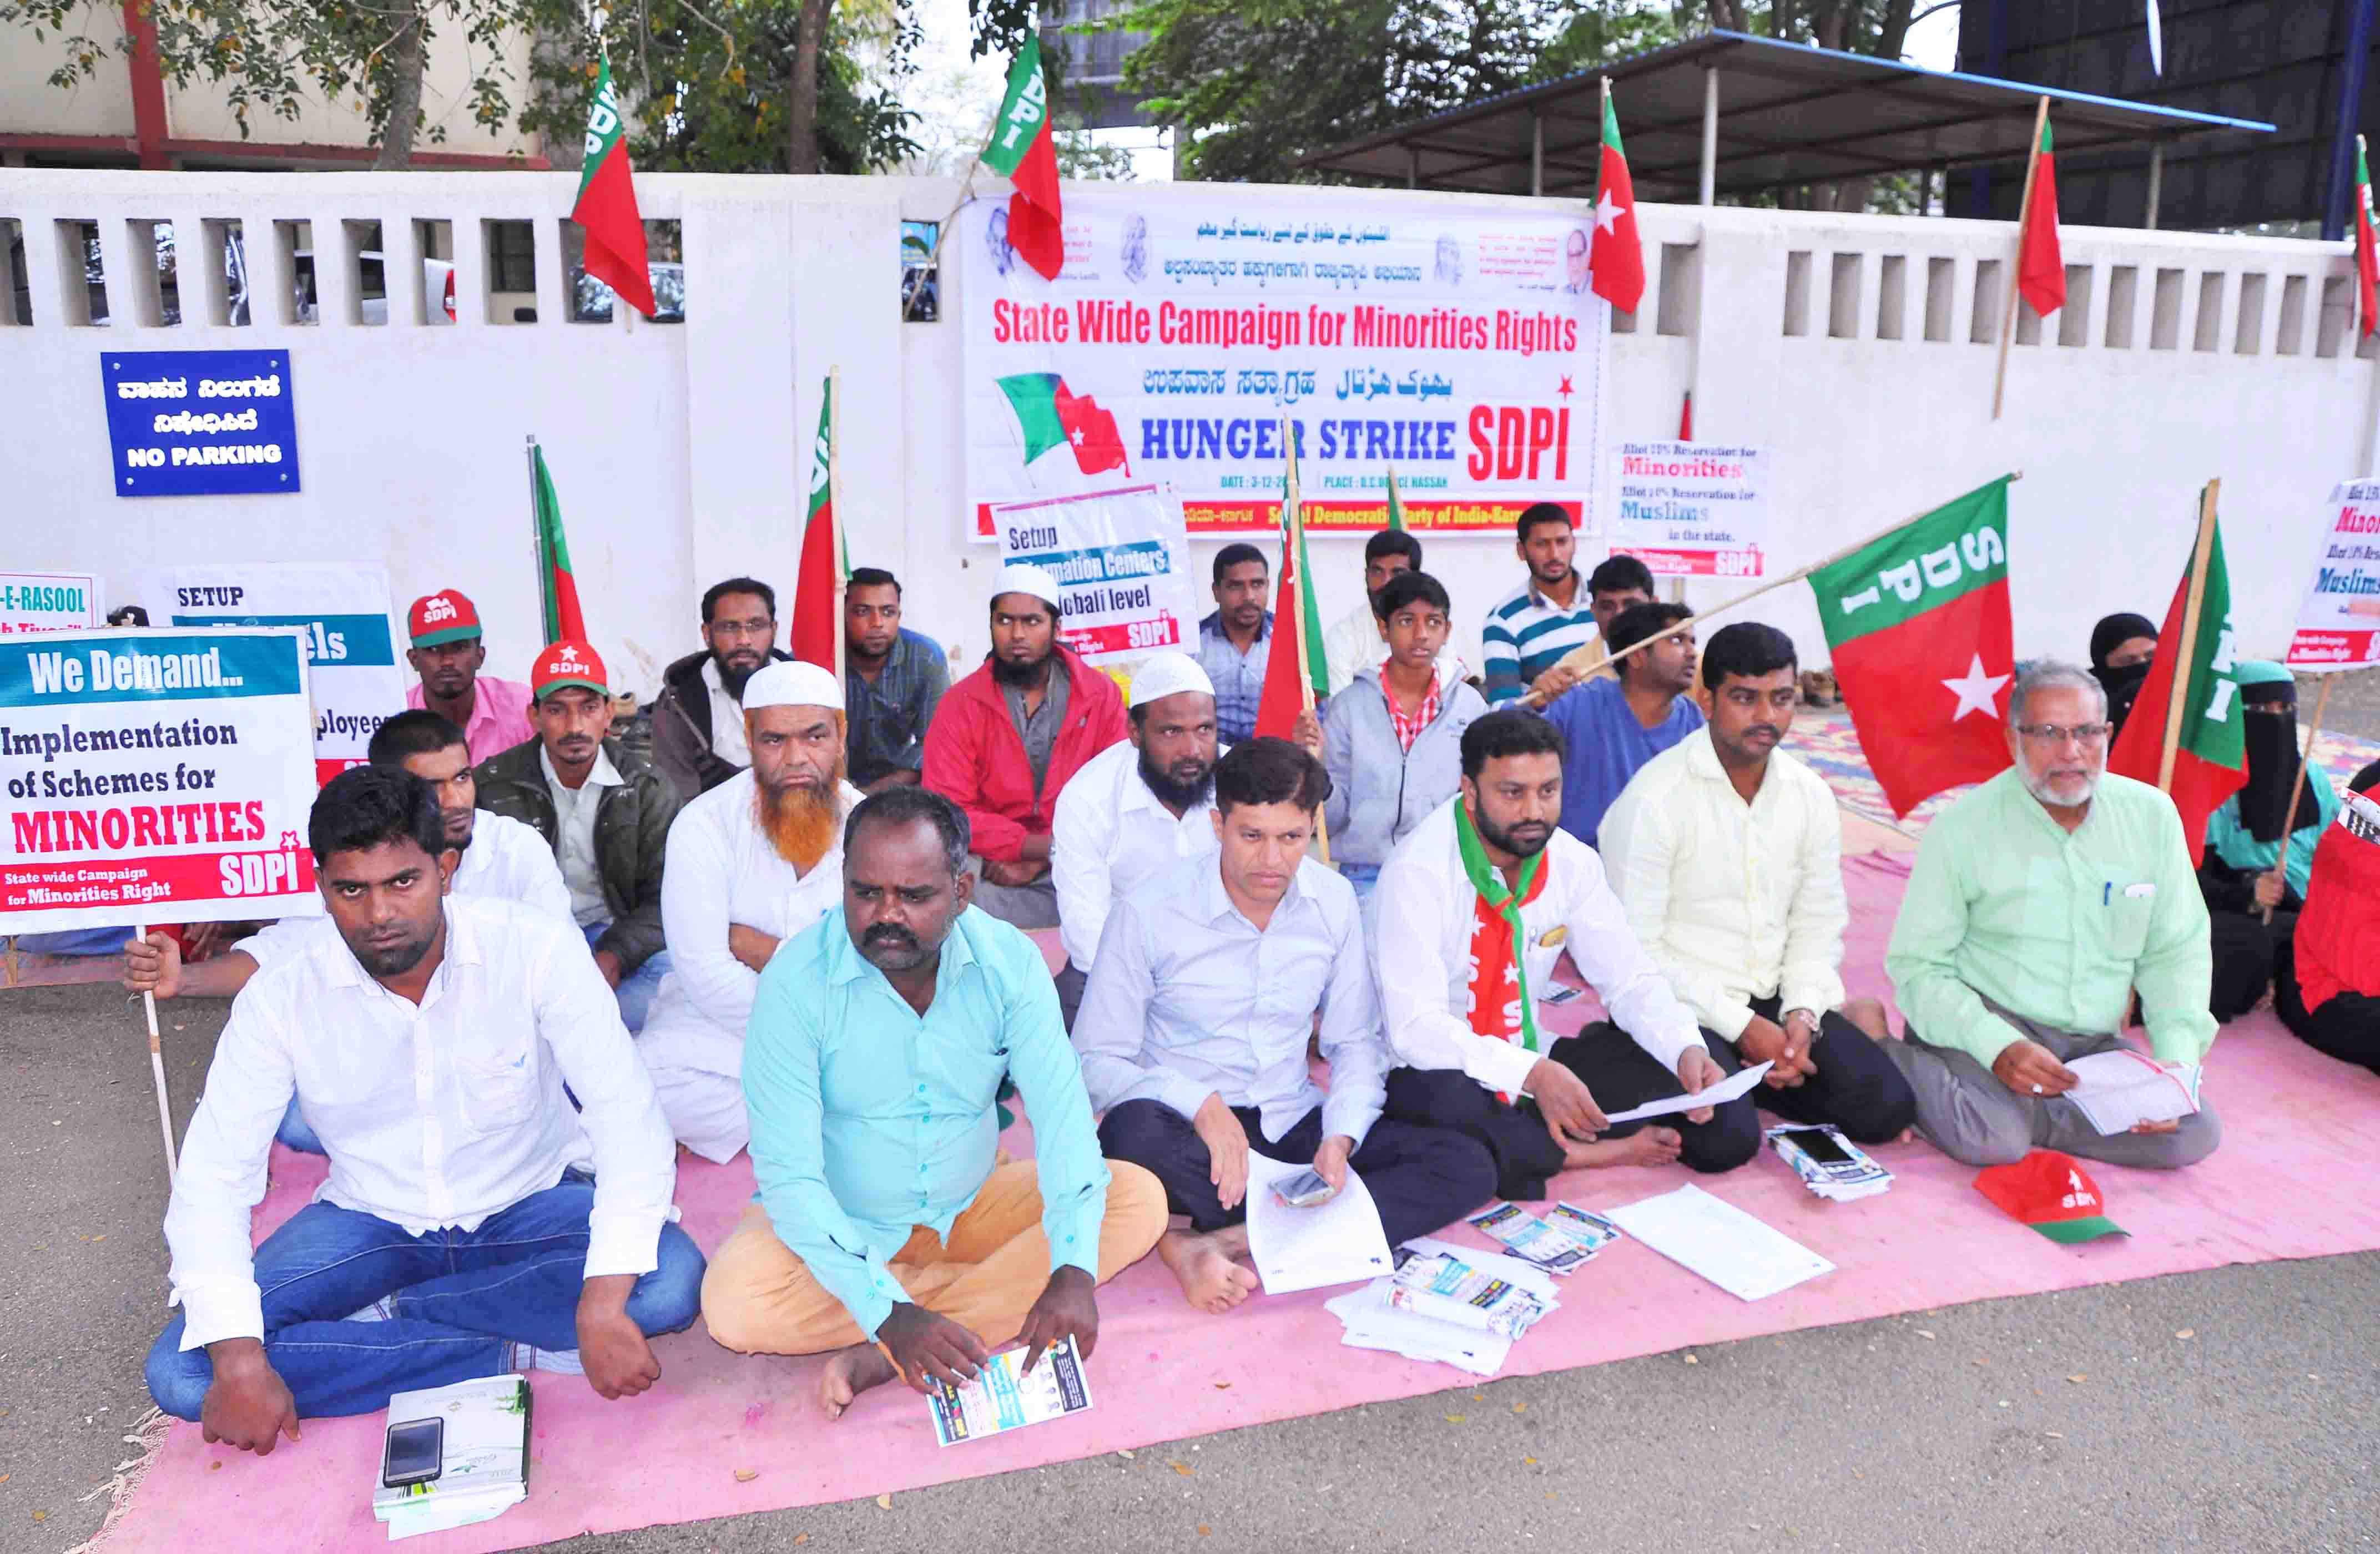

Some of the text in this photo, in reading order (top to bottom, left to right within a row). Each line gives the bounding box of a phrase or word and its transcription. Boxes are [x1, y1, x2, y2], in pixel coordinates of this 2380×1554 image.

[994, 298, 1578, 356] State Wide Campaign for Minorities Rights
[1141, 419, 1456, 460] HUNGER STRIKE
[1468, 405, 1570, 481] SDPI
[127, 444, 282, 467] NO PARKING
[1623, 456, 1743, 477] Minorities
[1221, 476, 1243, 488] DATE
[1324, 476, 1354, 488] PLACE
[1314, 506, 1389, 525] Democrati
[1437, 506, 1450, 524] of
[1621, 501, 1708, 521] Muslims
[1009, 526, 1058, 550] Setup
[1105, 549, 1165, 577] Centers
[1841, 526, 2005, 614] SDPI
[178, 587, 244, 607] SETUP
[1109, 584, 1151, 610] level
[1128, 619, 1172, 648] SDPI
[28, 647, 244, 694] We Demand...
[549, 663, 590, 675] SDPI
[316, 709, 390, 741] ployee
[1, 718, 238, 763] Implementation
[8, 763, 216, 799] of Schemes for
[11, 800, 266, 854] MINORITIES
[4, 867, 148, 886] State wide Campaign
[219, 850, 299, 897] SDPI
[7, 881, 172, 906] for Minorities Right
